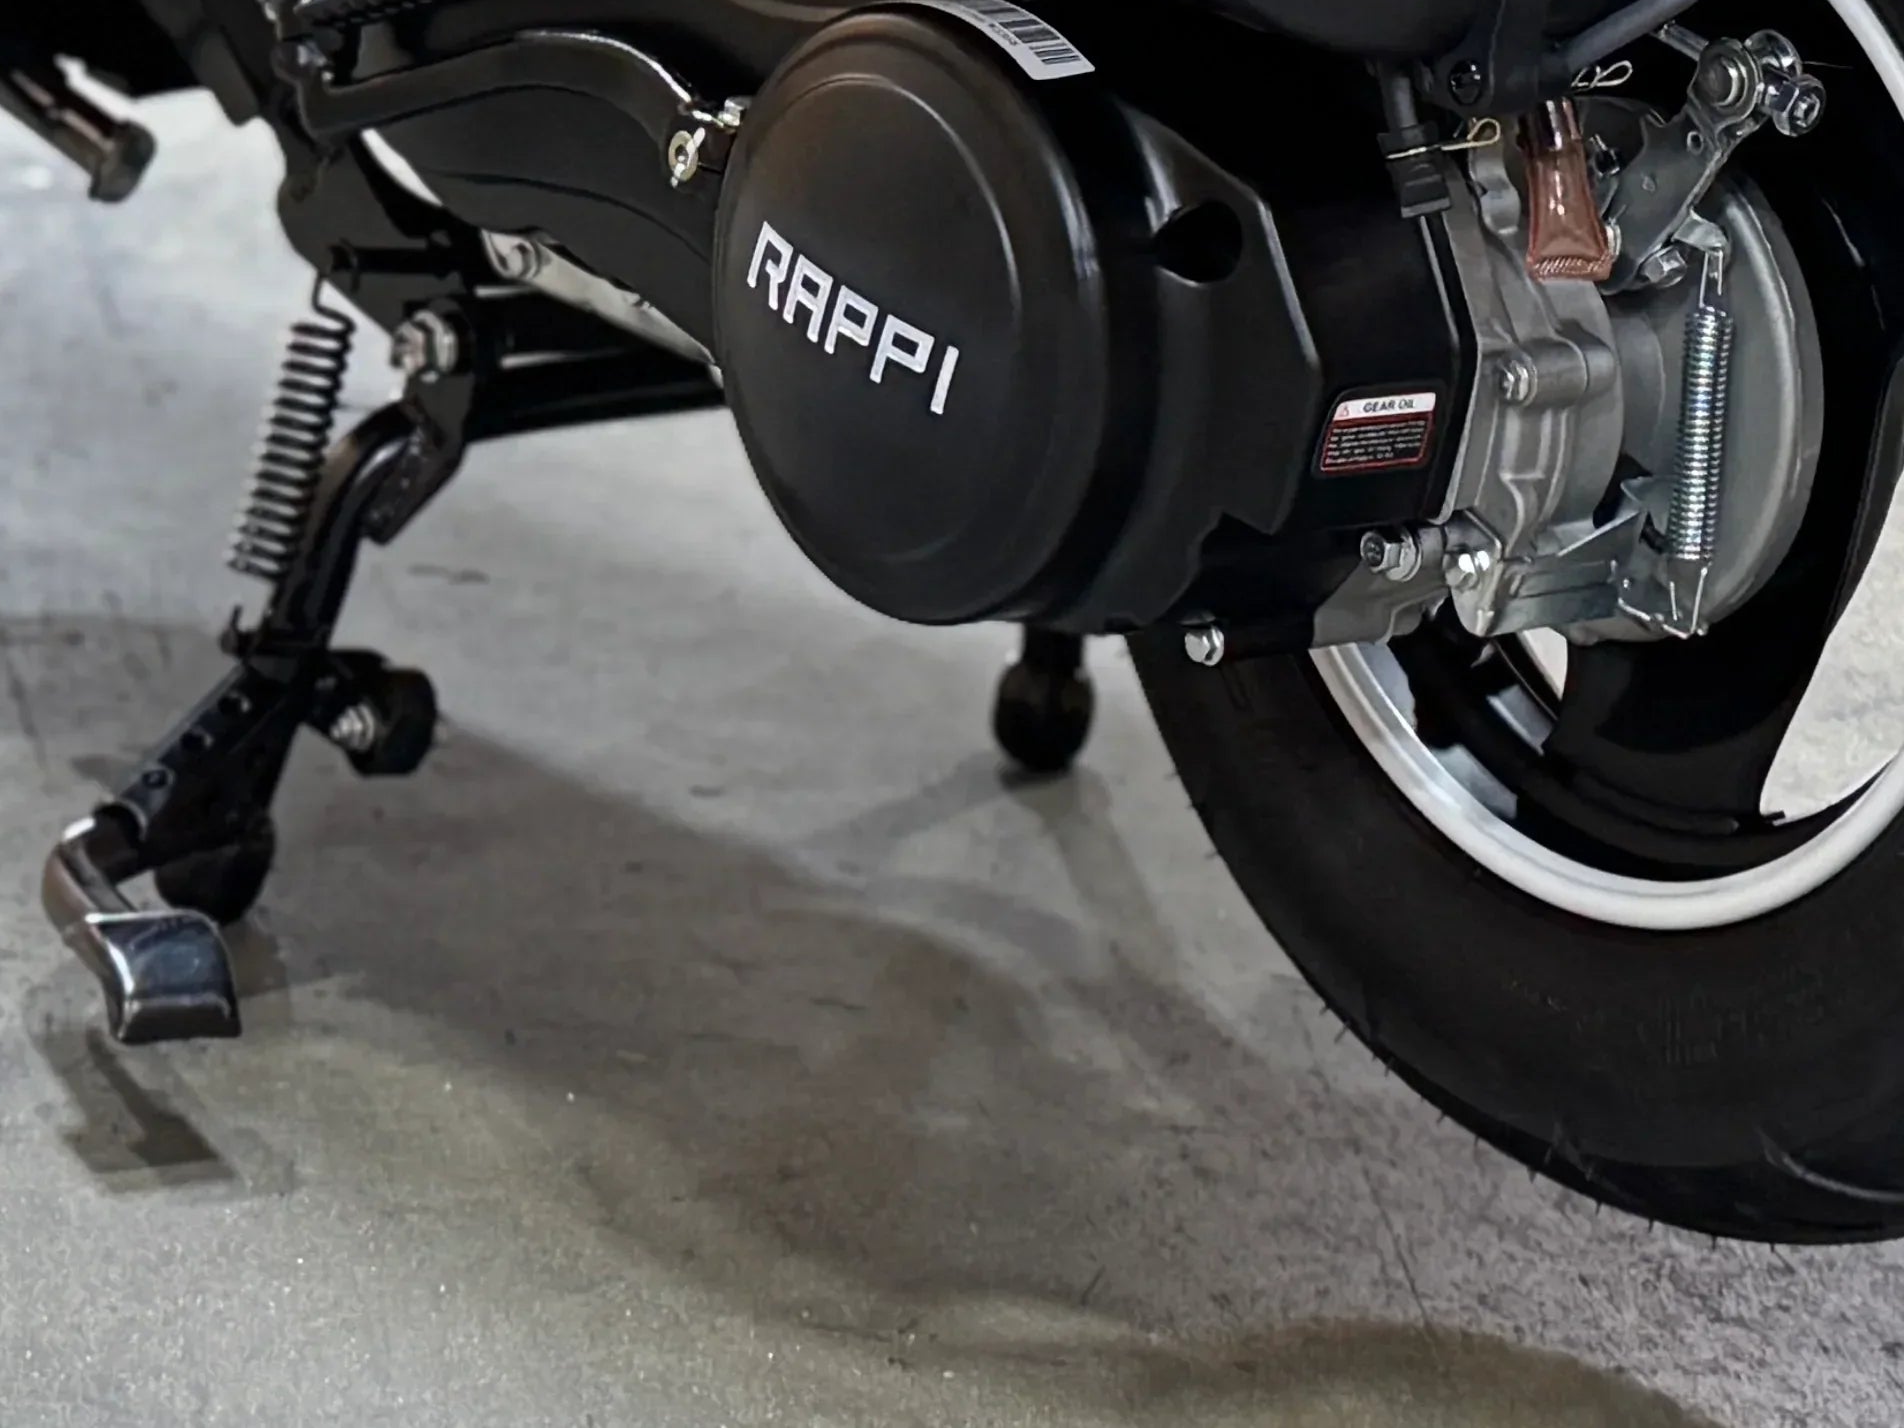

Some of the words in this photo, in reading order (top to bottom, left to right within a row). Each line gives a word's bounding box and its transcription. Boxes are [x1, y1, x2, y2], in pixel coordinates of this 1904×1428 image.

[746, 220, 960, 416] RAPPI
[1362, 400, 1396, 414] GEAR
[1397, 398, 1416, 410] OIL
